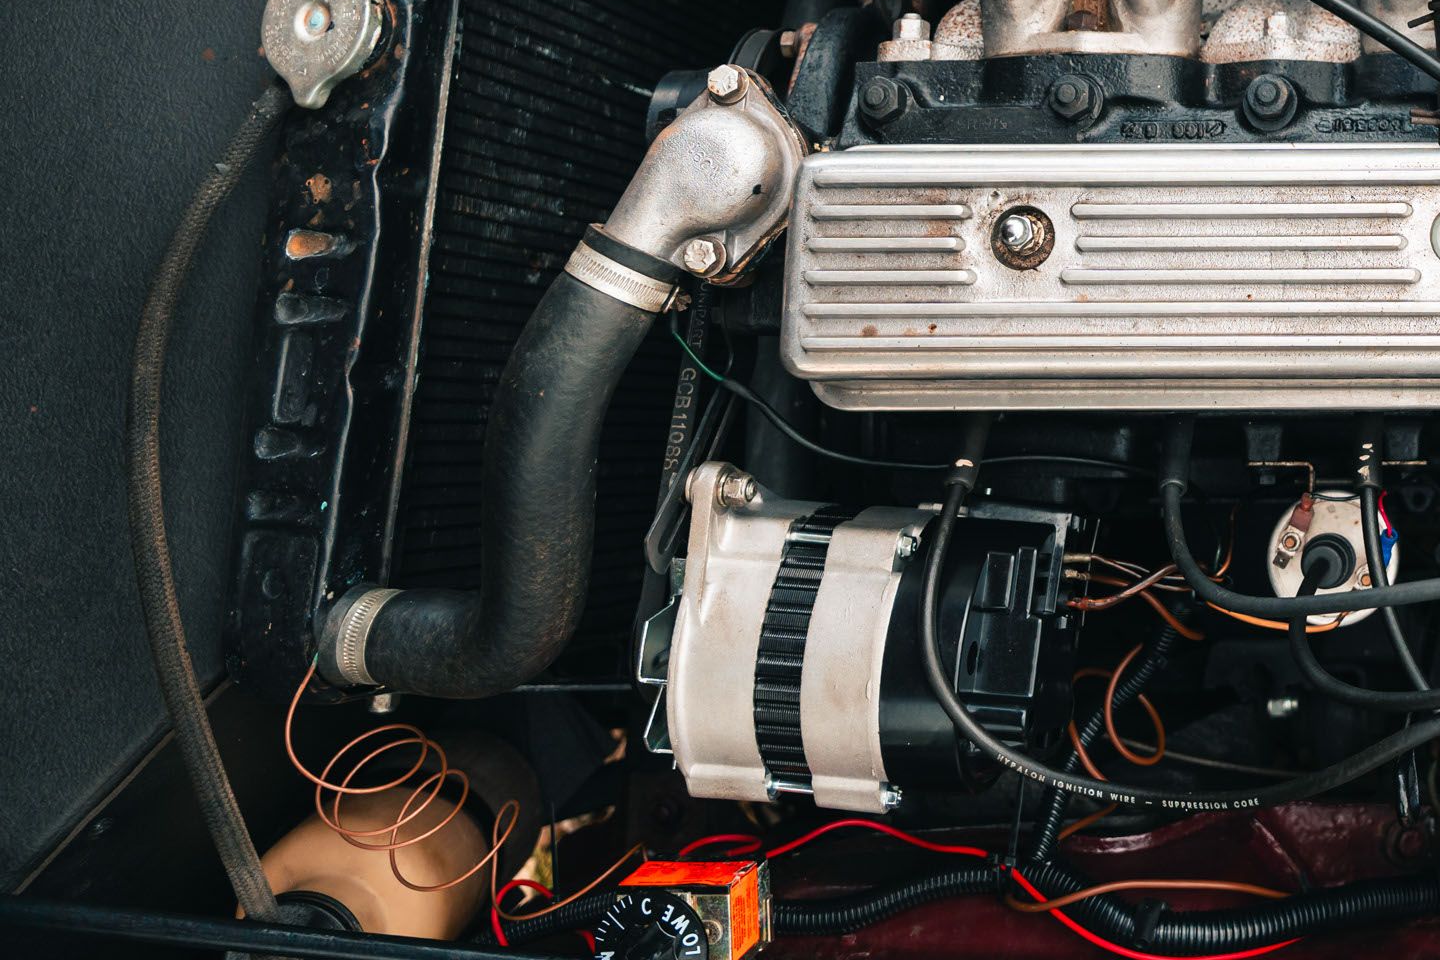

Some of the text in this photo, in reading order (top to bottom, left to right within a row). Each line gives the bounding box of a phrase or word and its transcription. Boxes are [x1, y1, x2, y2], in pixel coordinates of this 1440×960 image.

[997, 753, 1046, 783] HYPALON
[1053, 778, 1103, 799] IGNITION
[1110, 792, 1136, 804] WIRE
[1162, 799, 1228, 810] SUPPRESSION
[1234, 797, 1260, 809] CORE
